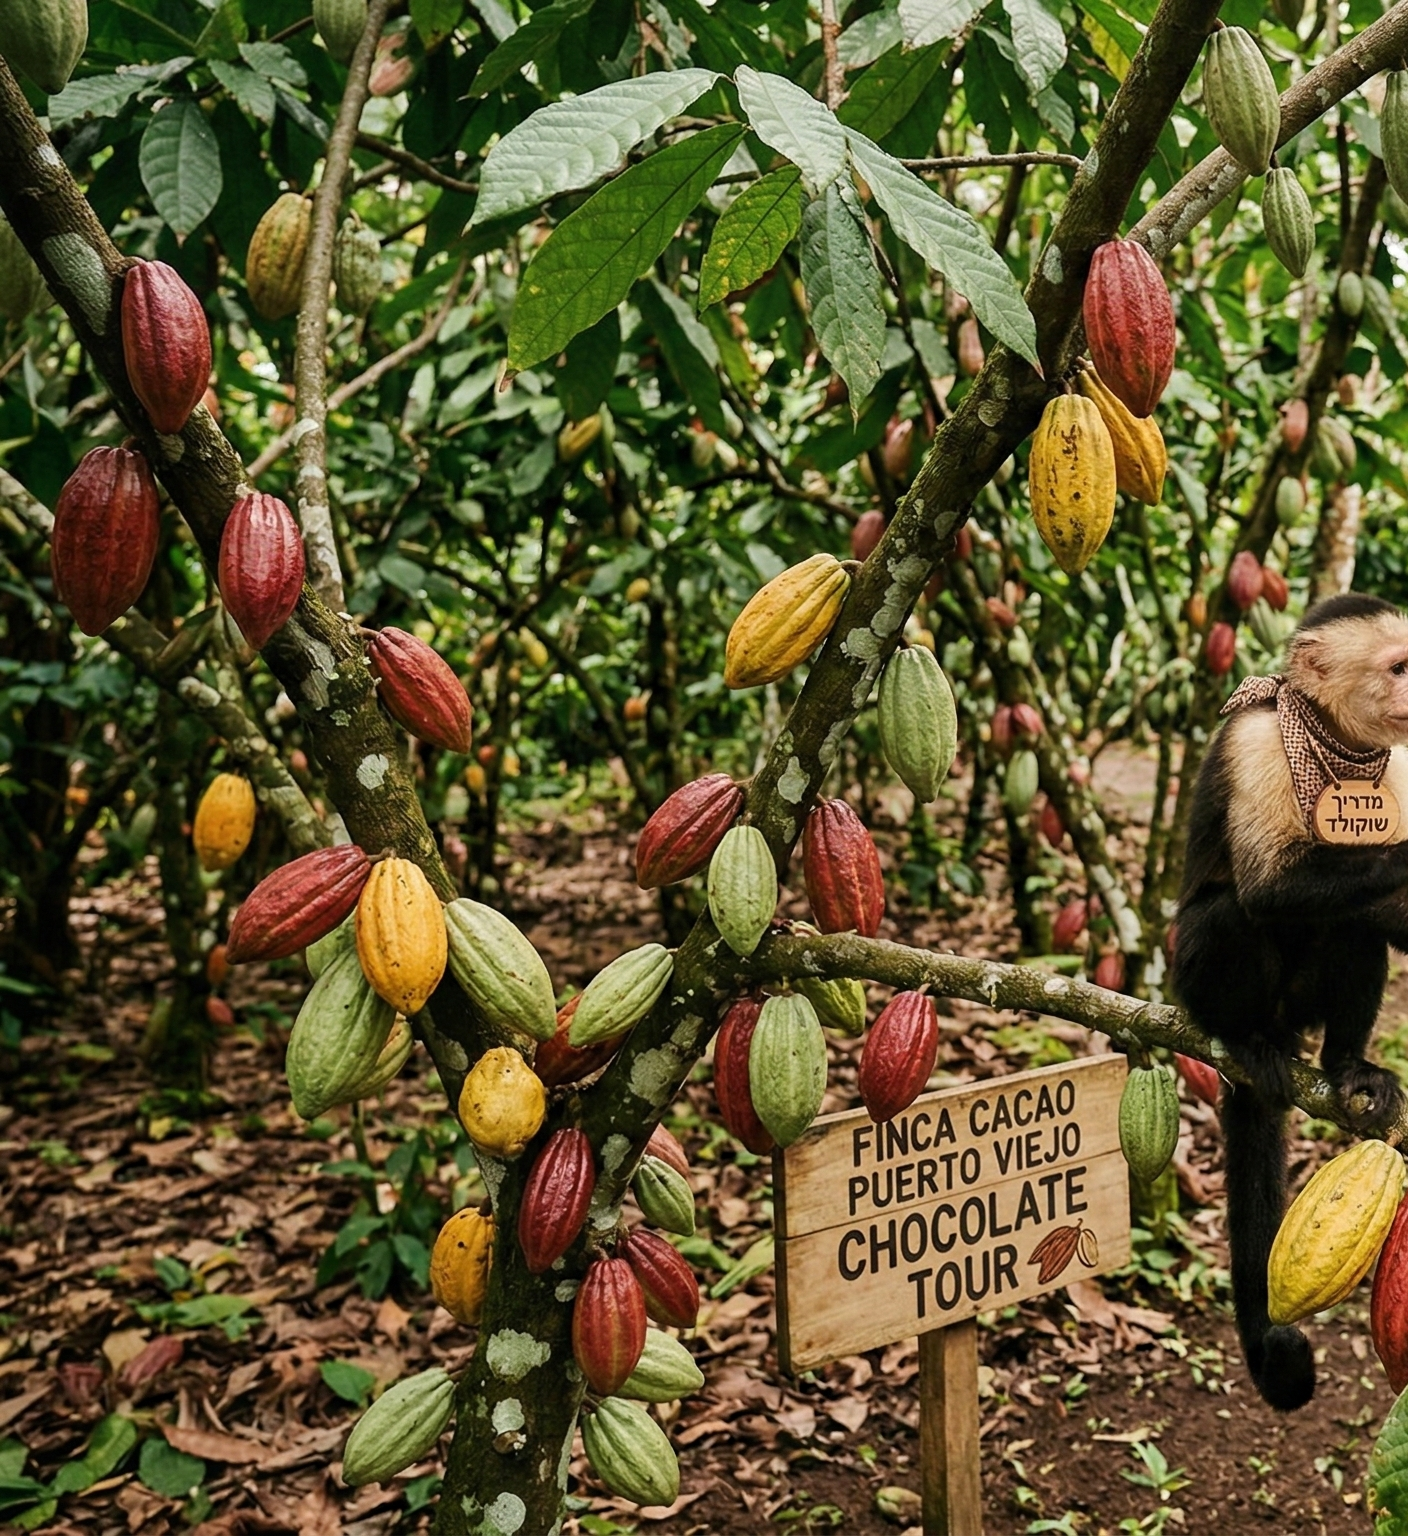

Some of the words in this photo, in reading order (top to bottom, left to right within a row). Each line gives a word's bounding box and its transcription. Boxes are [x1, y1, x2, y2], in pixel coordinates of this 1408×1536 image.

[1325, 813, 1389, 837] שוקולד
[1331, 795, 1383, 813] מדריך
[853, 1108, 956, 1167] FINCA
[969, 1079, 1075, 1137] CACAO
[848, 1147, 981, 1216] PUERTO
[993, 1122, 1081, 1175] VIEJO
[838, 1166, 1088, 1281] CHOCOLATE
[907, 1244, 1019, 1318] TOUR
